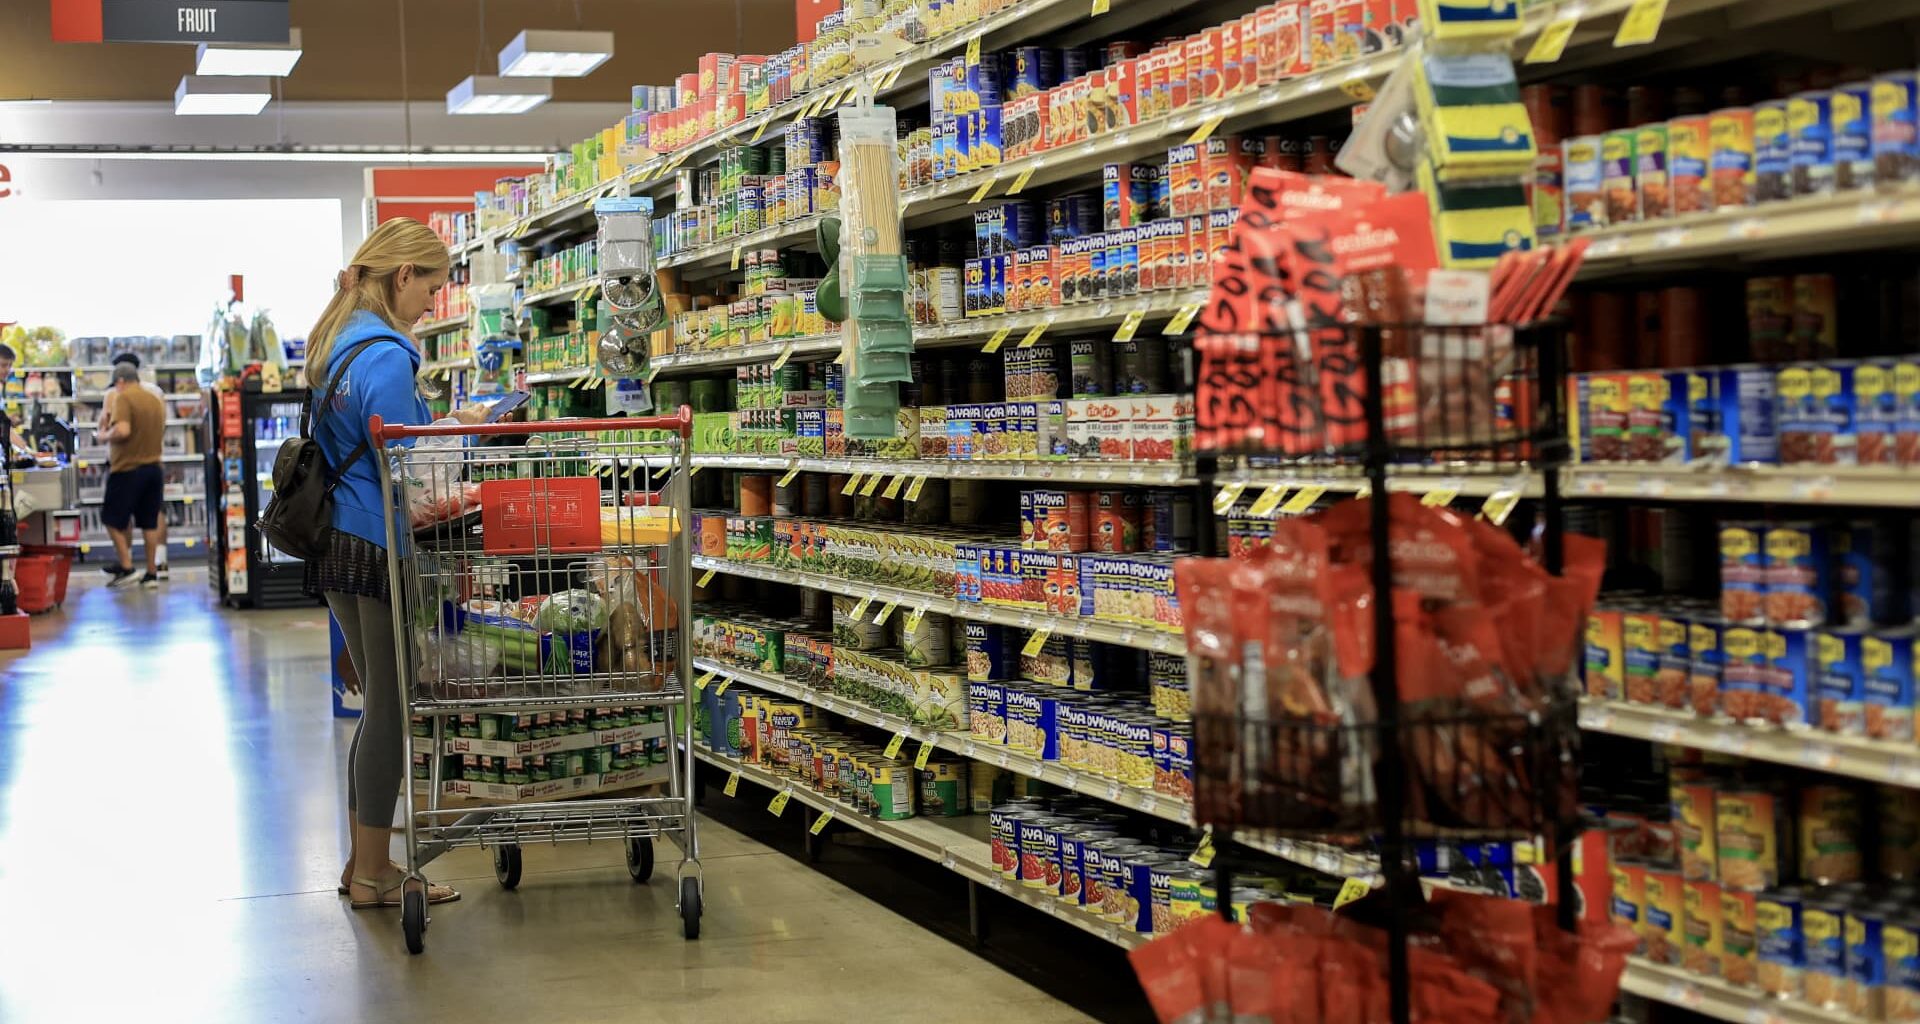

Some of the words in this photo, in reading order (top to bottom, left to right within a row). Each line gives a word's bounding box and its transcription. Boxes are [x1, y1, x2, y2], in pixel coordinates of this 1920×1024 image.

[178, 8, 216, 32] FRUIT
[1031, 348, 1054, 359] OYA
[1072, 343, 1093, 354] OYA
[966, 626, 985, 637] OYA
[970, 685, 987, 697] OYA
[1127, 728, 1150, 740] OYA
[1022, 828, 1043, 840] OYA
